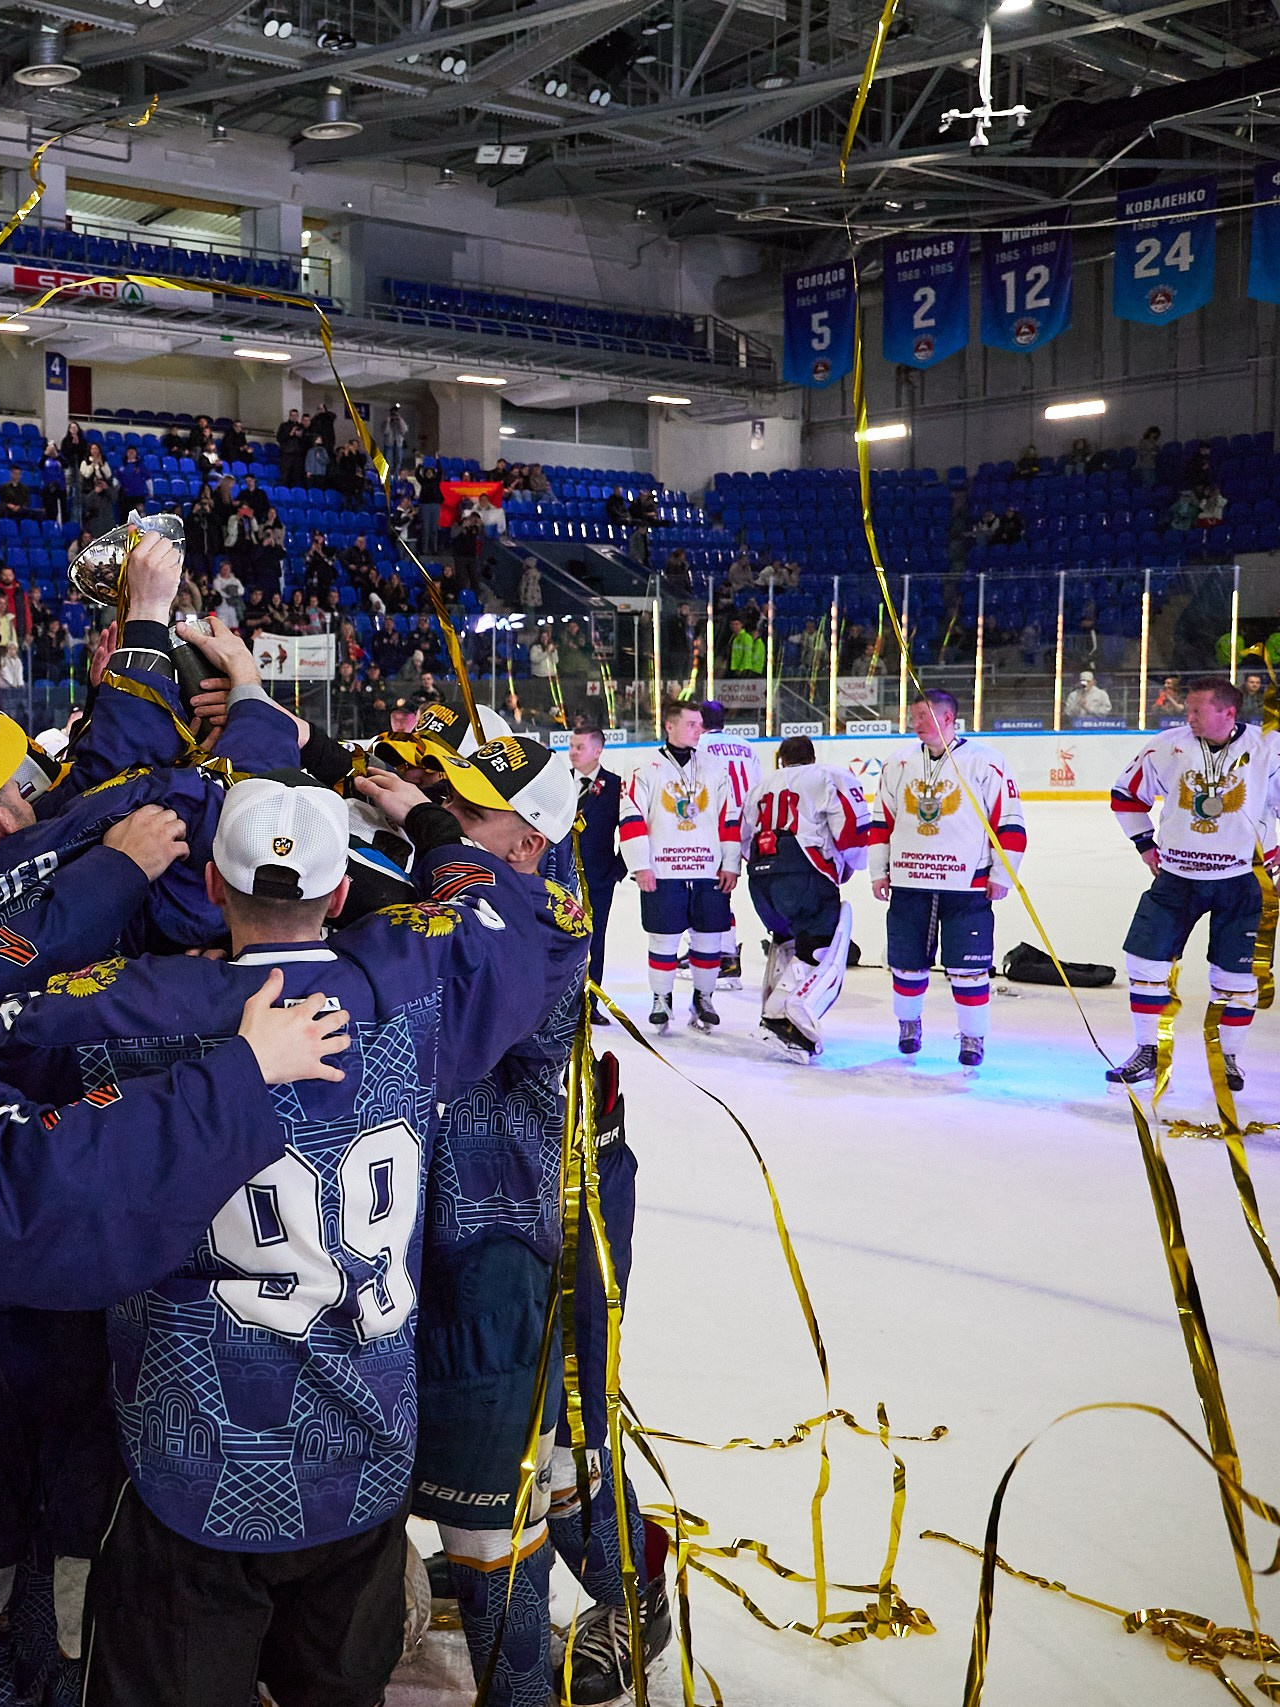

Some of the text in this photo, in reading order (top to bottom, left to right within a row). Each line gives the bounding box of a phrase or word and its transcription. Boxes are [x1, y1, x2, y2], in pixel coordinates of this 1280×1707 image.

[1125, 189, 1206, 215] КОВАЛЕНКО
[895, 241, 955, 264] АСТАФЬЕВ
[1134, 231, 1194, 279] 24
[796, 268, 845, 290] СОЛОДОВ
[1001, 264, 1050, 314] 12
[913, 286, 936, 329] 2
[811, 310, 831, 351] 5
[50, 357, 60, 375] 4
[428, 720, 445, 733] 25
[490, 756, 509, 772] 25
[901, 851, 957, 862] ПРОКУРАТУРА
[1168, 848, 1237, 862] ПРОКУРАТУРА
[893, 861, 966, 872] НИЖЕГОРОДСКОЙ
[908, 871, 946, 880] ОБЛАСТИ
[206, 1117, 422, 1345] 99
[418, 1481, 511, 1507] BAUER
